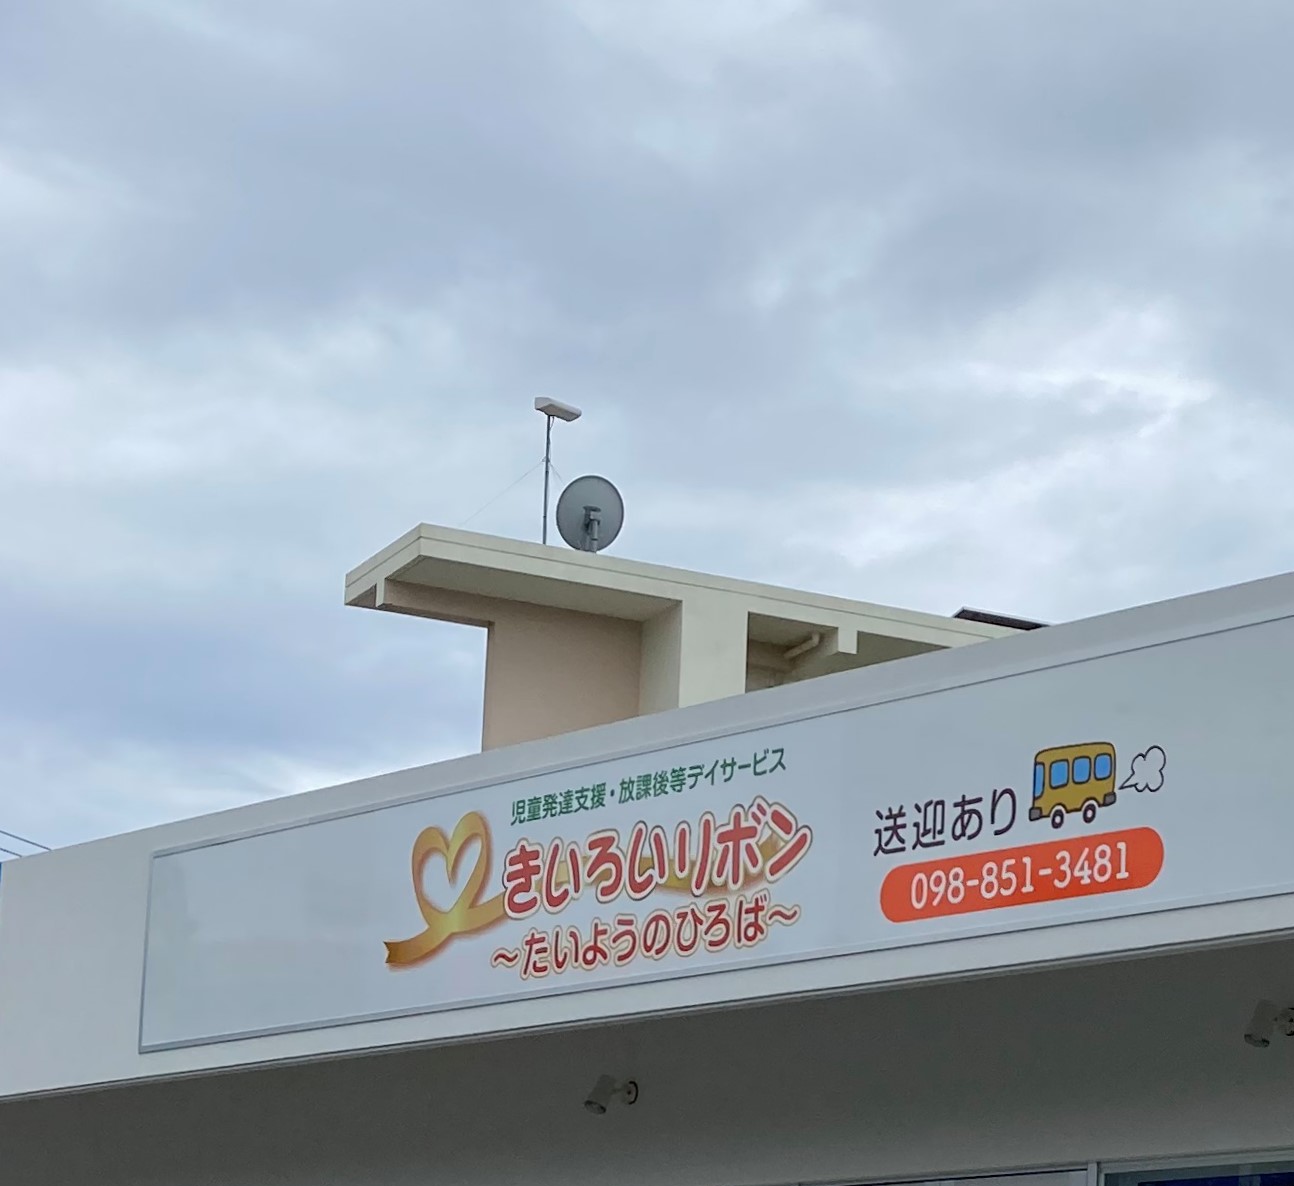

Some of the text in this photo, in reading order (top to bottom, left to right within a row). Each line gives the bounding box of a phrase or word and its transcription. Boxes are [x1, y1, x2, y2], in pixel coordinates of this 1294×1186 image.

[510, 748, 787, 826] 児童発達支援・放課後等デイサービス
[873, 787, 1017, 856] 送迎あり
[503, 796, 811, 918] きいろいリボン
[910, 841, 1130, 910] 098-851-3481
